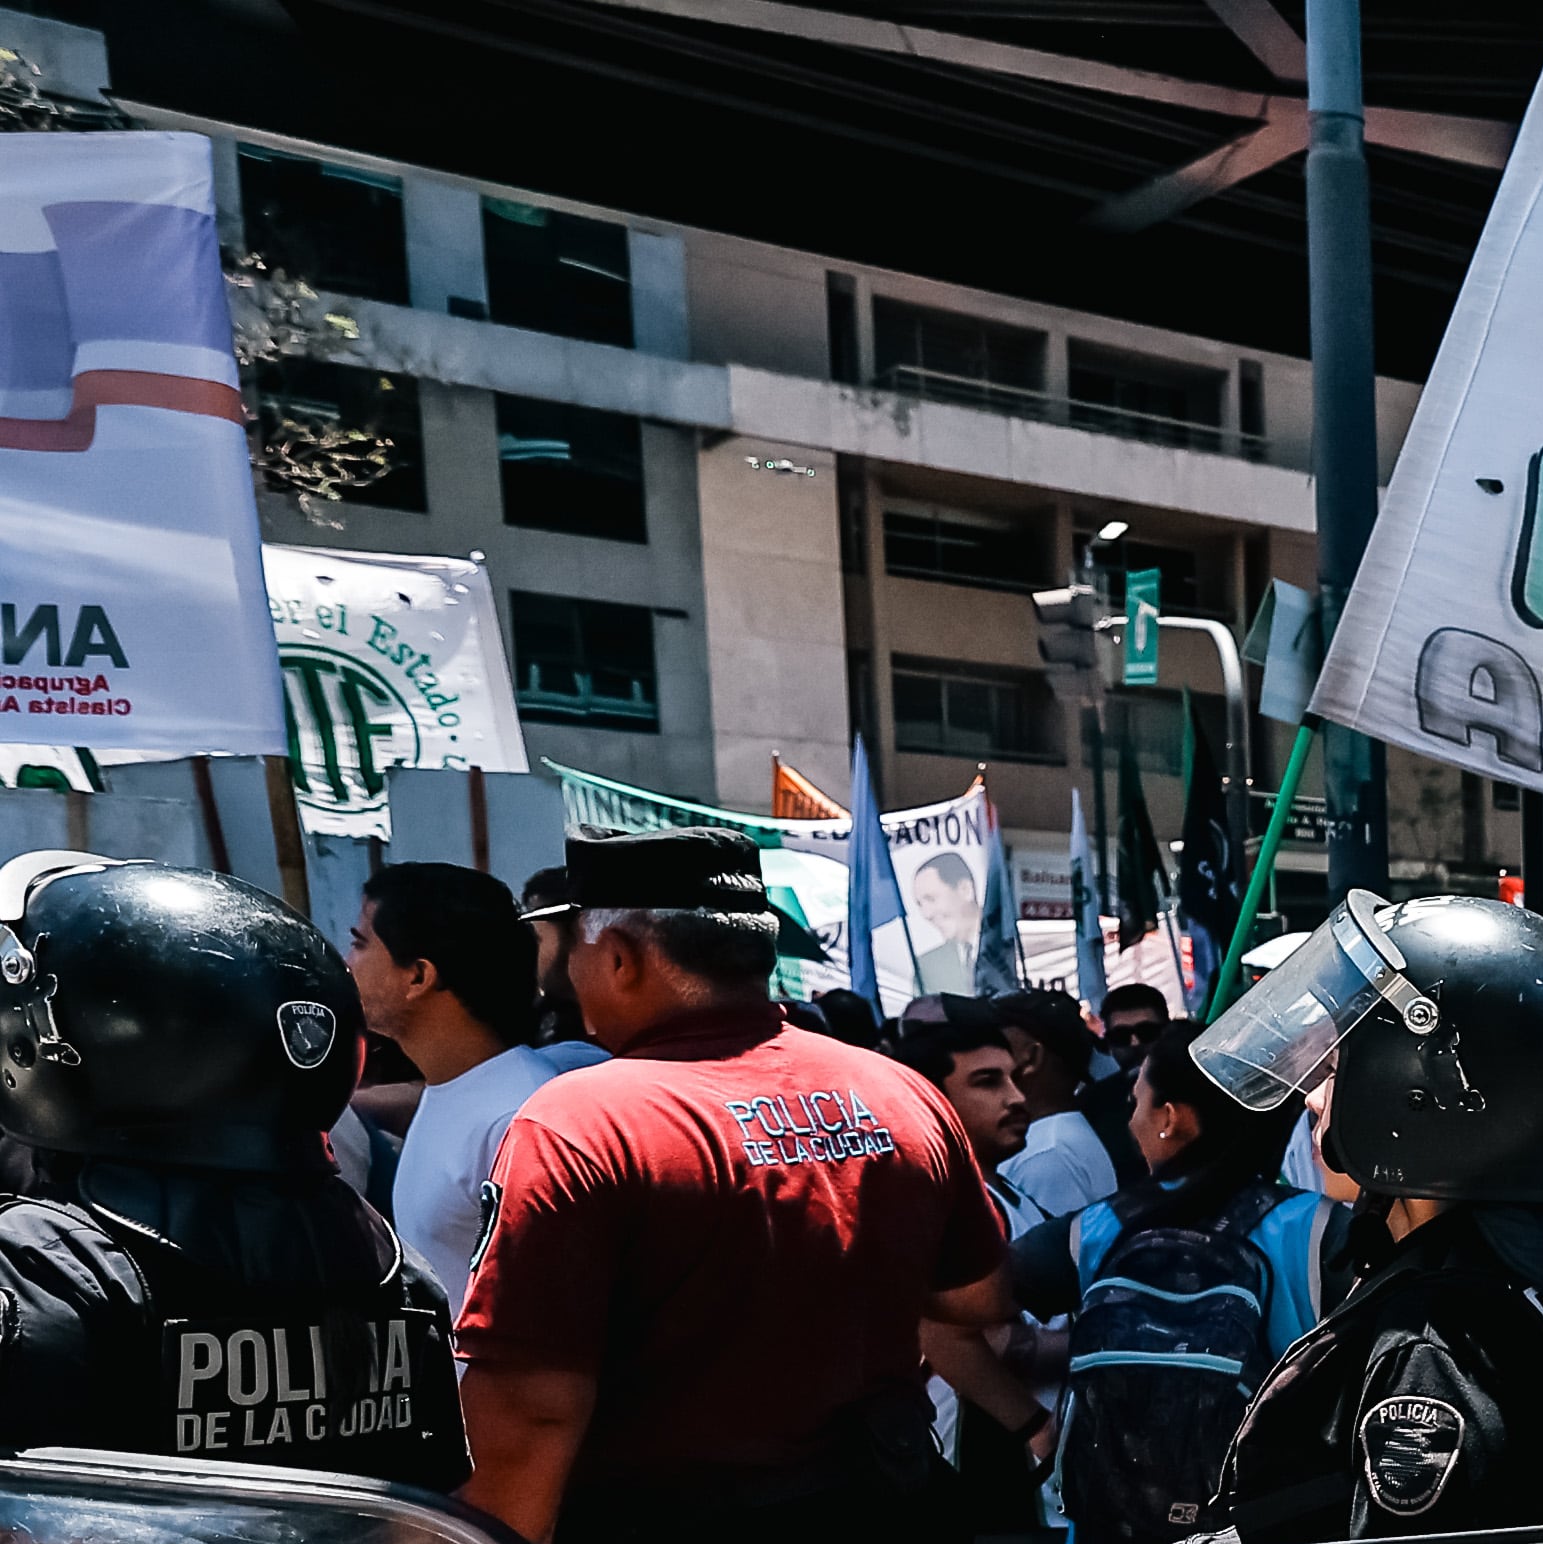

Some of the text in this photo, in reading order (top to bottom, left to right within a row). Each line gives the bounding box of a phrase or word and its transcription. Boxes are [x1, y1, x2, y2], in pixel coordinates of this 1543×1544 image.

[725, 1088, 879, 1139] POLICIA
[742, 1128, 895, 1166] DE LA CIUDAD
[177, 1412, 231, 1452] DE
[244, 1408, 293, 1447] LA
[1380, 1403, 1438, 1424] POLICIA
